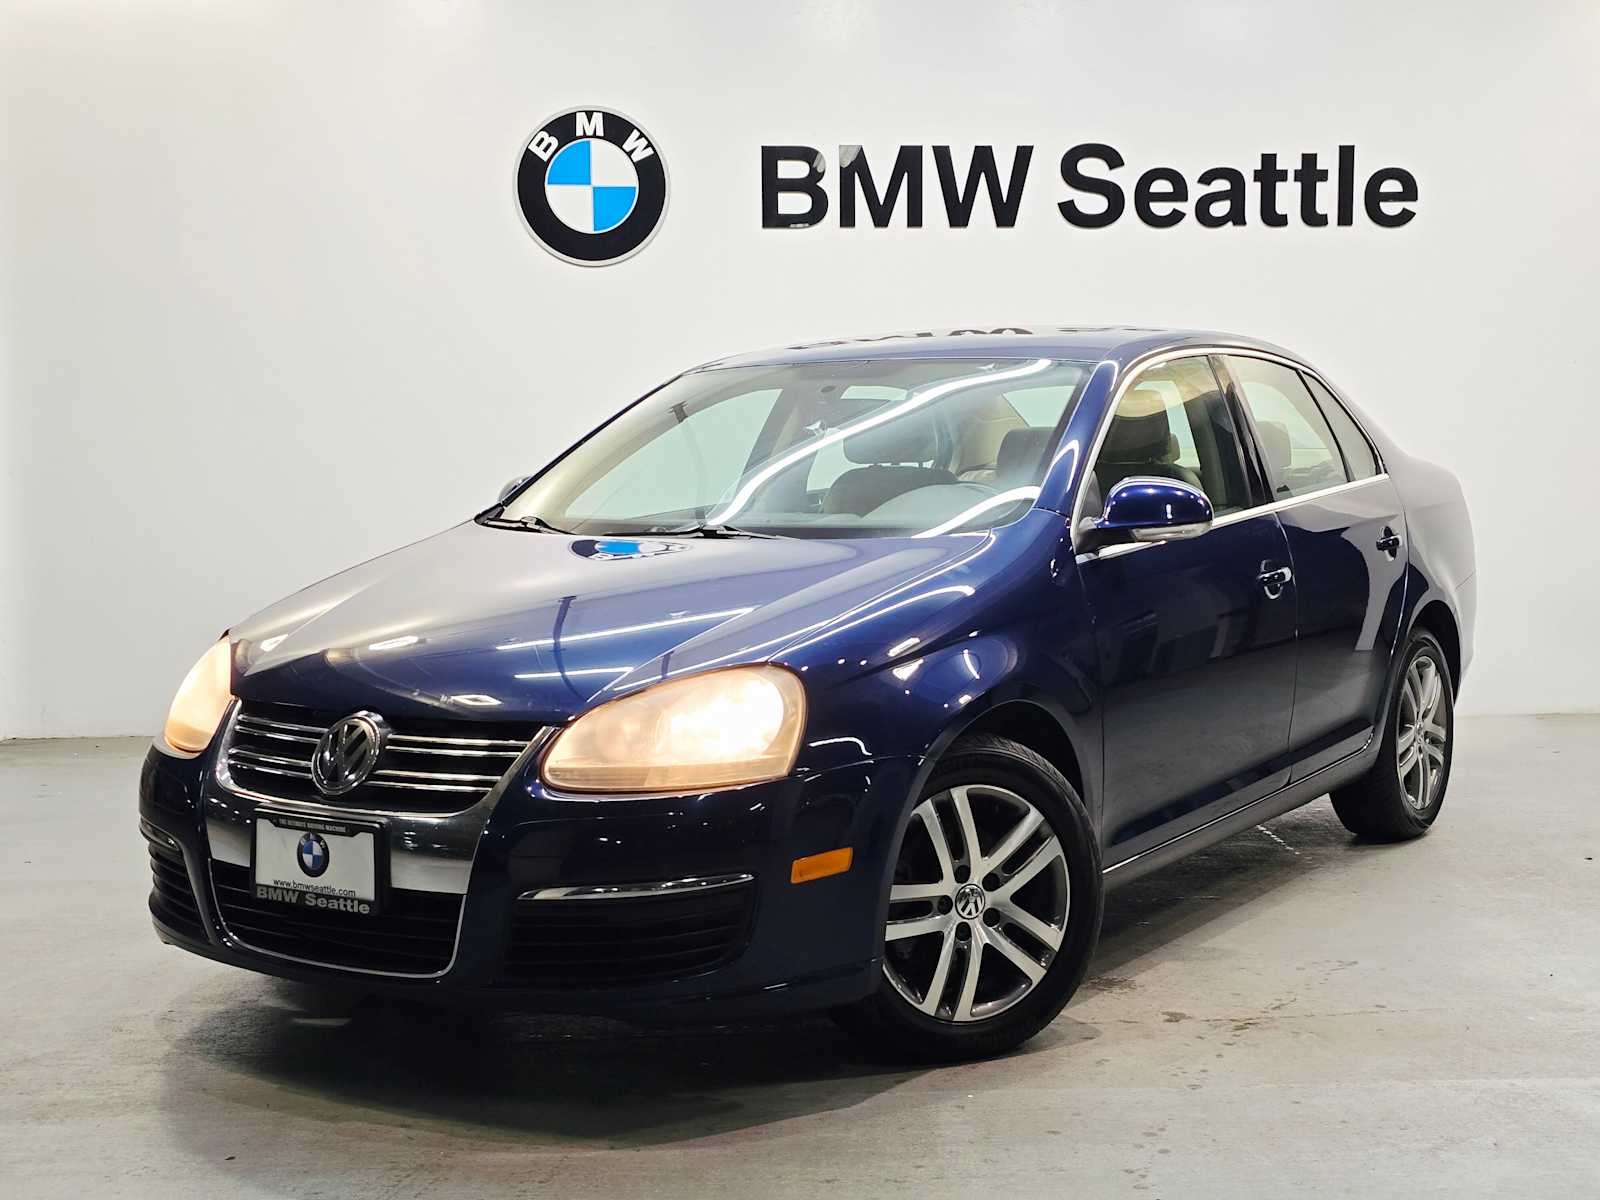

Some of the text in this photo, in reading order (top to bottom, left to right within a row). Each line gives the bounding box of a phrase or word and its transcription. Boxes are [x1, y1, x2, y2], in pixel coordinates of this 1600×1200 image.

[527, 111, 655, 163] BMW
[761, 143, 1419, 229] BMW Seattle
[256, 886, 370, 914] BMW Seattle
[273, 879, 356, 897] www.bmwseattle.com
